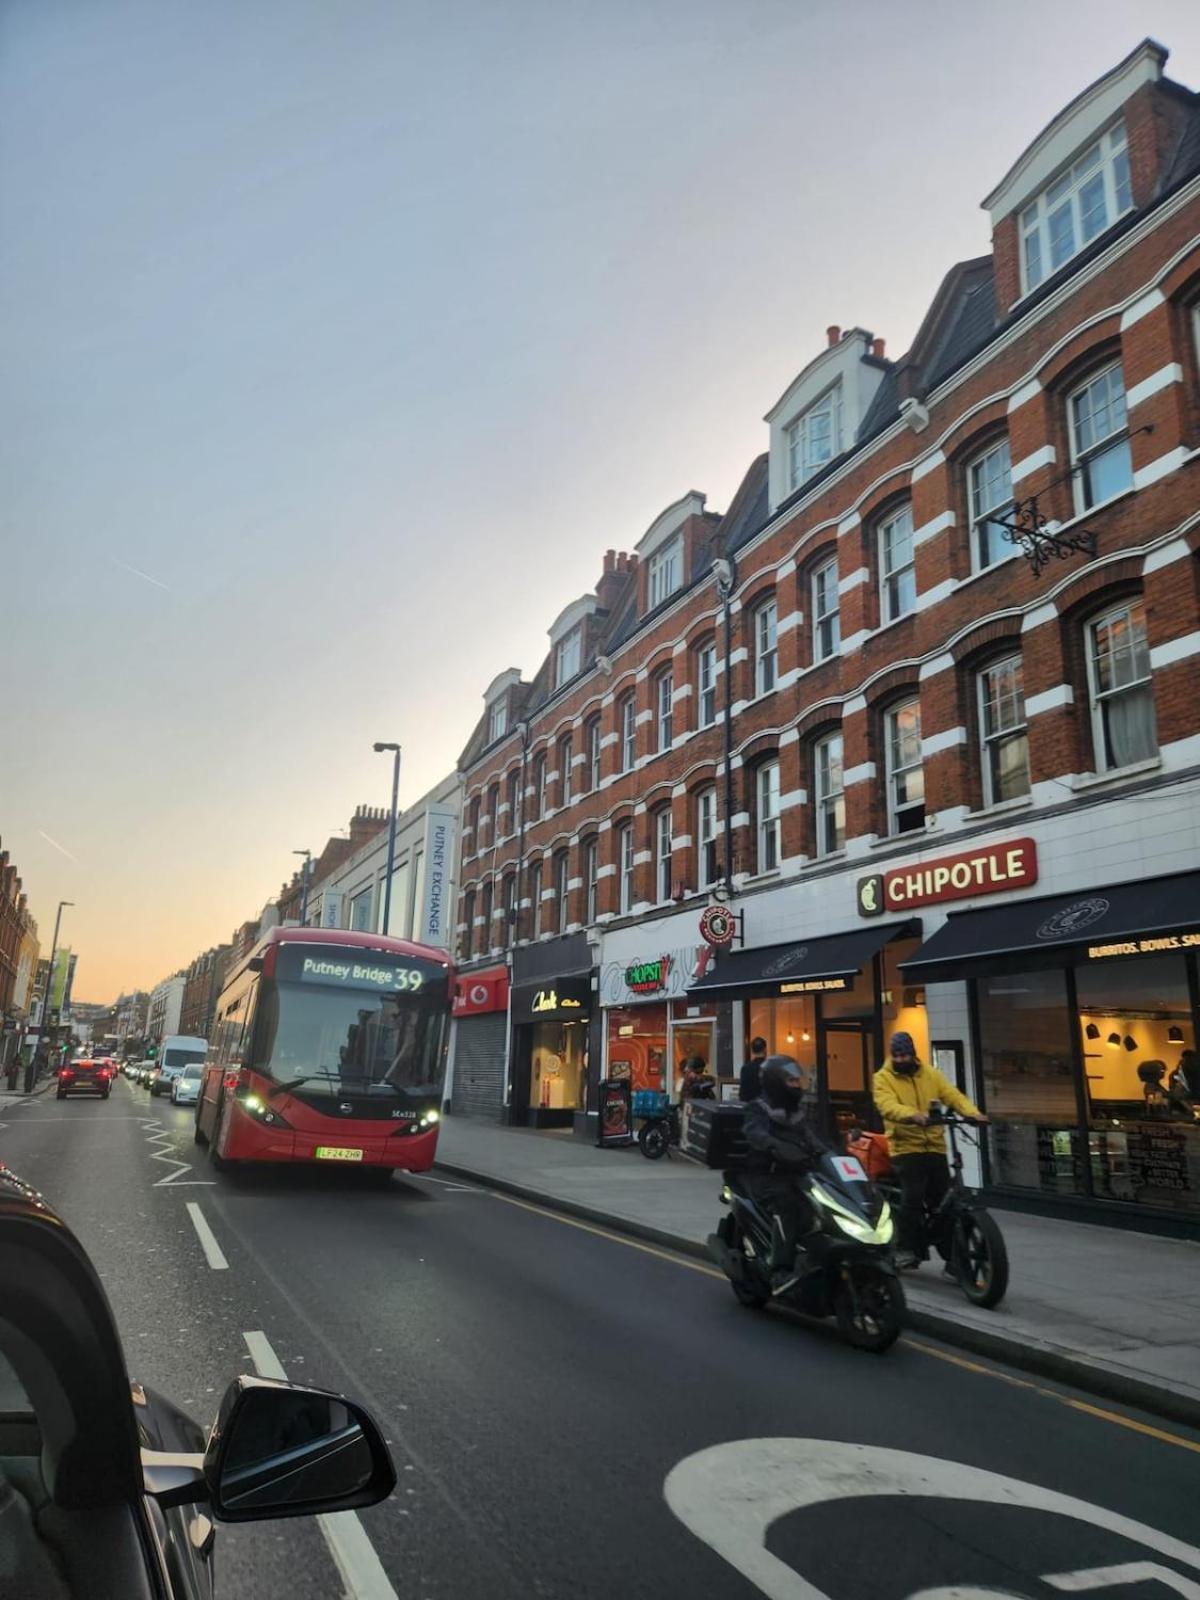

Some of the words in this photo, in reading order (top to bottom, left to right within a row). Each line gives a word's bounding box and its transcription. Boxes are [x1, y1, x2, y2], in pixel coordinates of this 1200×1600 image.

[434, 825, 446, 868] PUTNEY
[888, 849, 1026, 902] CHIPOTLE
[428, 871, 443, 936] EXCHANGE
[303, 958, 350, 980] Putney
[352, 965, 393, 985] Bridge
[394, 967, 423, 992] 39
[841, 1161, 858, 1175] L
